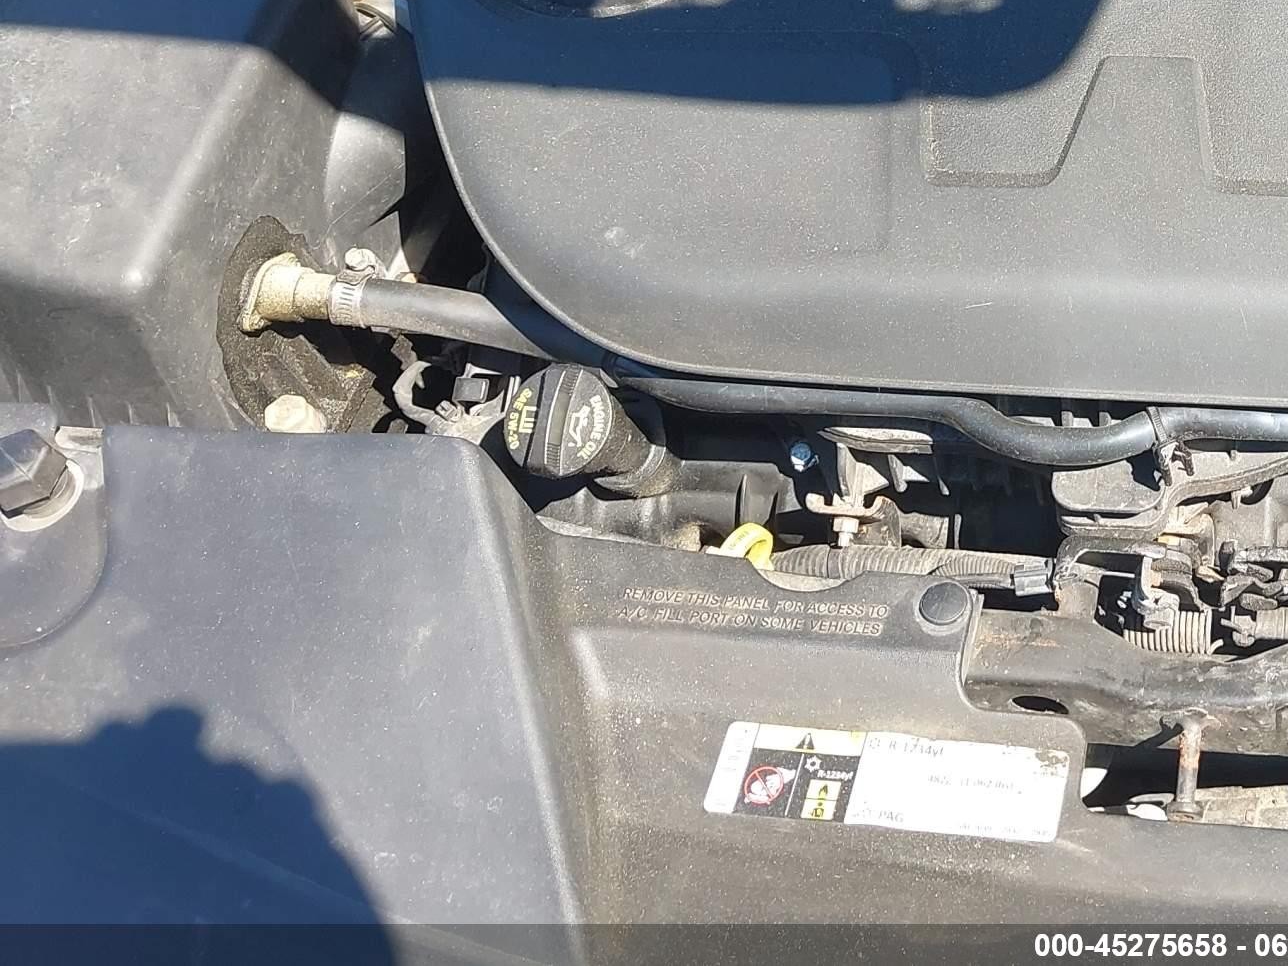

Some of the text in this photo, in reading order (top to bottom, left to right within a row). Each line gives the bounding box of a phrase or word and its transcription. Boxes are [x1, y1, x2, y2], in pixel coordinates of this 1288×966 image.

[507, 388, 534, 450] SAE 5W-20
[576, 394, 606, 460] ENGINE OIL
[618, 606, 883, 636] A/C FILL PORT ON SOME VEHICLES
[622, 587, 890, 619] REMOVE THIS PANEL FOR ACCESS TO
